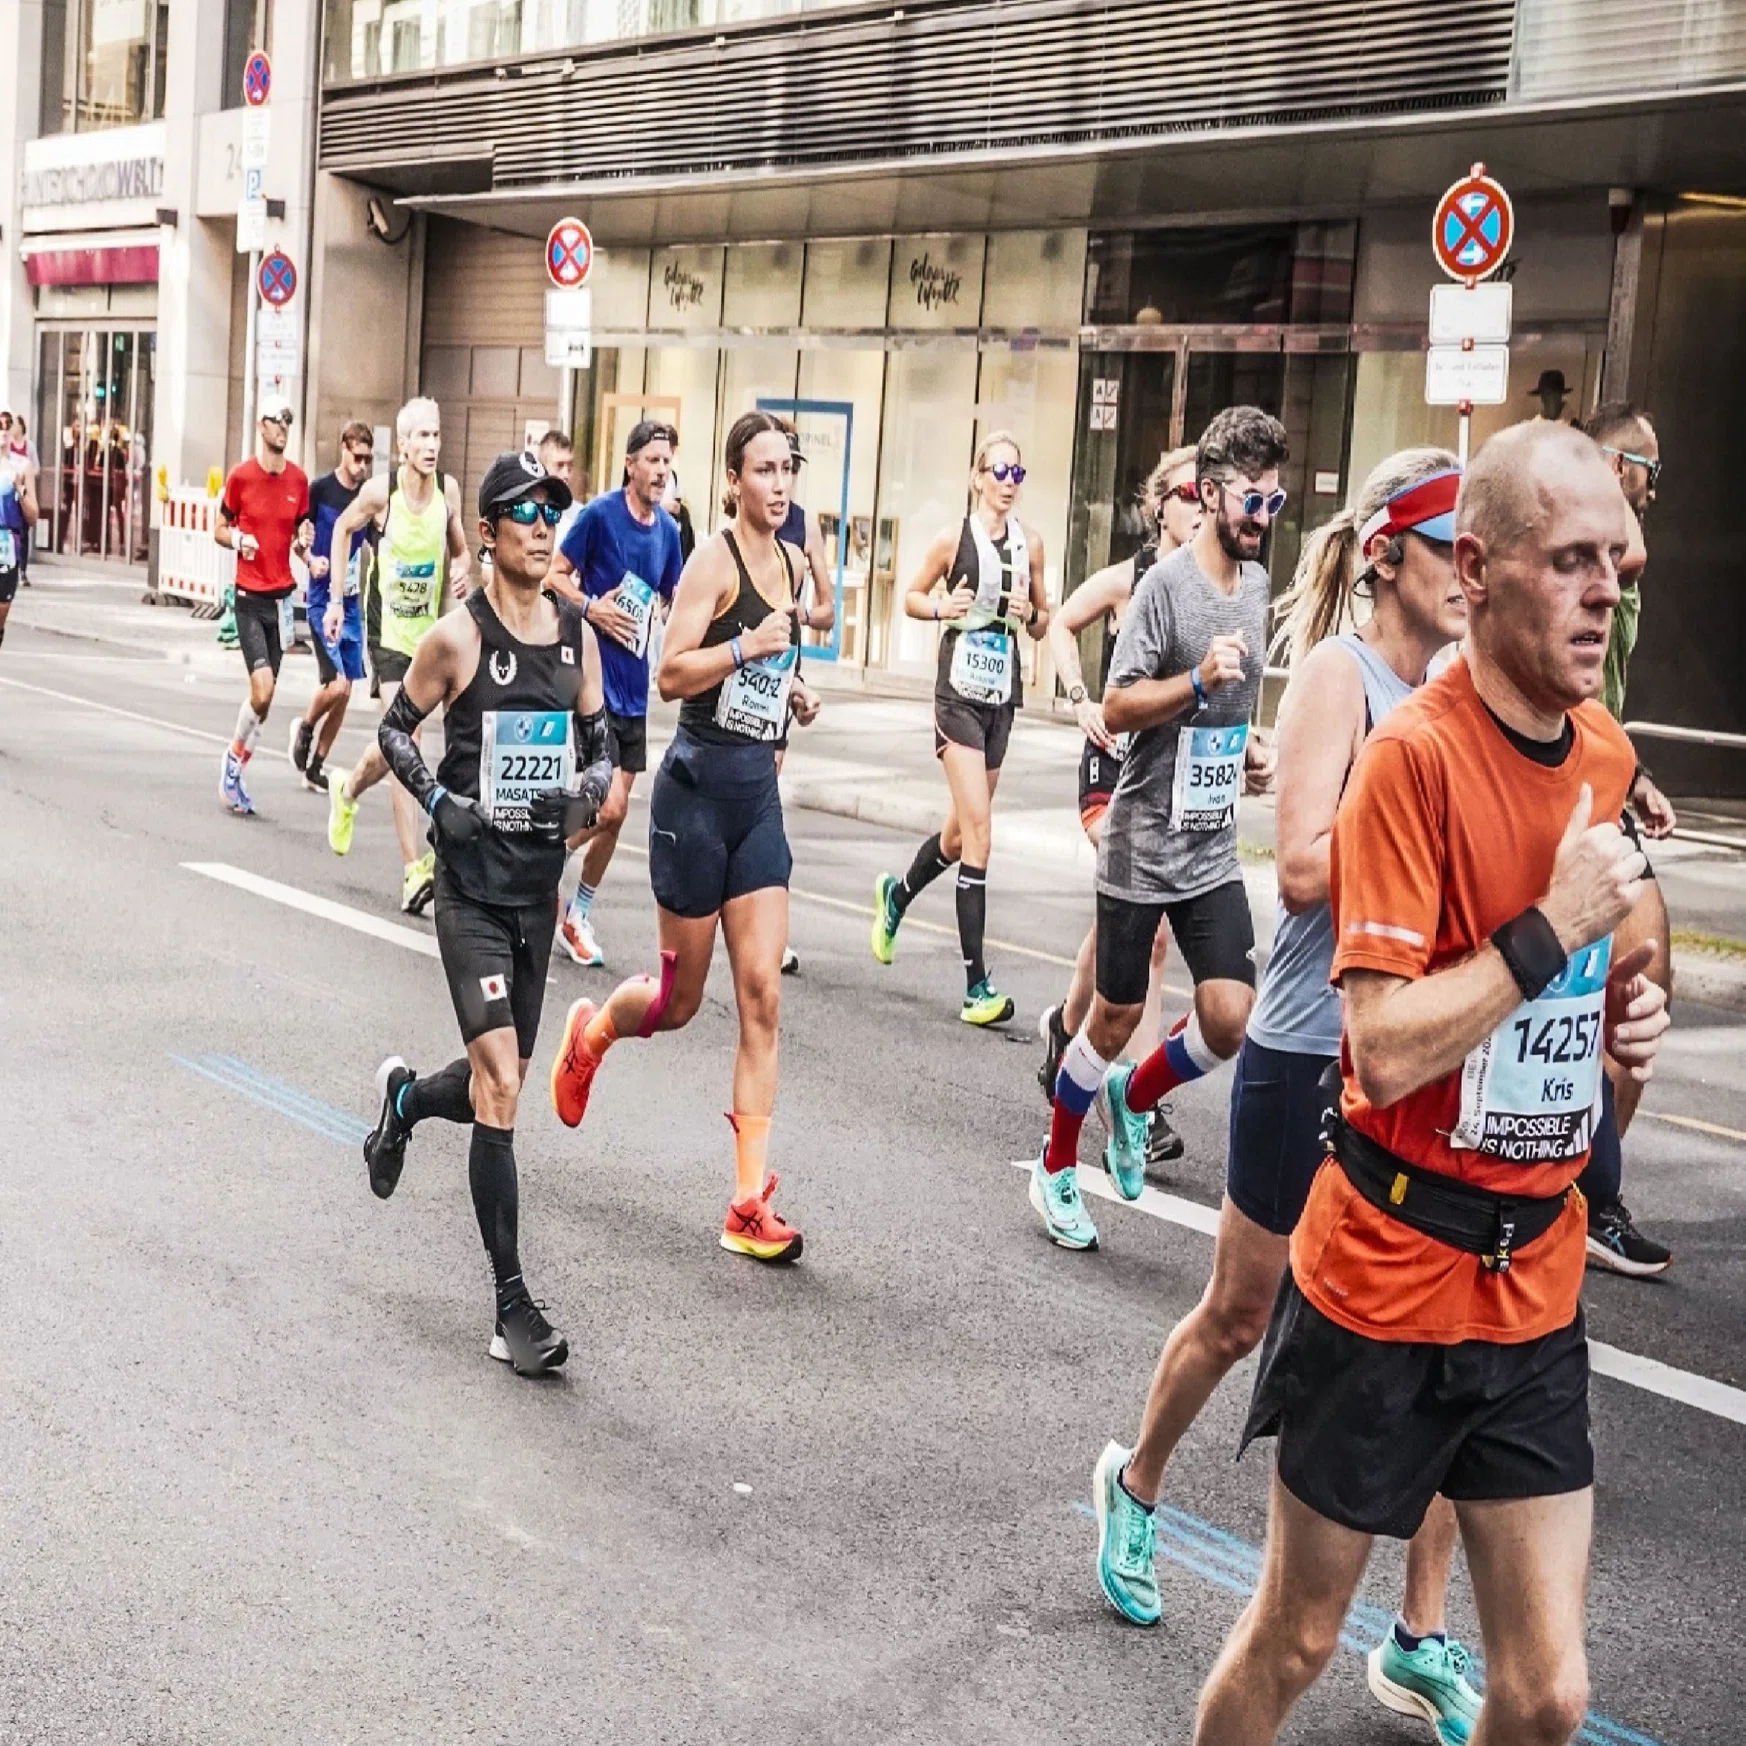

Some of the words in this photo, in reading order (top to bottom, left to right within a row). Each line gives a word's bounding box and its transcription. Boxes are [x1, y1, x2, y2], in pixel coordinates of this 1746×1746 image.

[966, 651, 1005, 674] 15300
[501, 755, 561, 780] 22221
[1514, 1011, 1601, 1064] 14257
[1541, 1077, 1574, 1102] Kris
[1486, 1115, 1571, 1137] IMPOSSIBLE
[1480, 1138, 1498, 1154] IS
[1500, 1139, 1565, 1160] NOTHING
